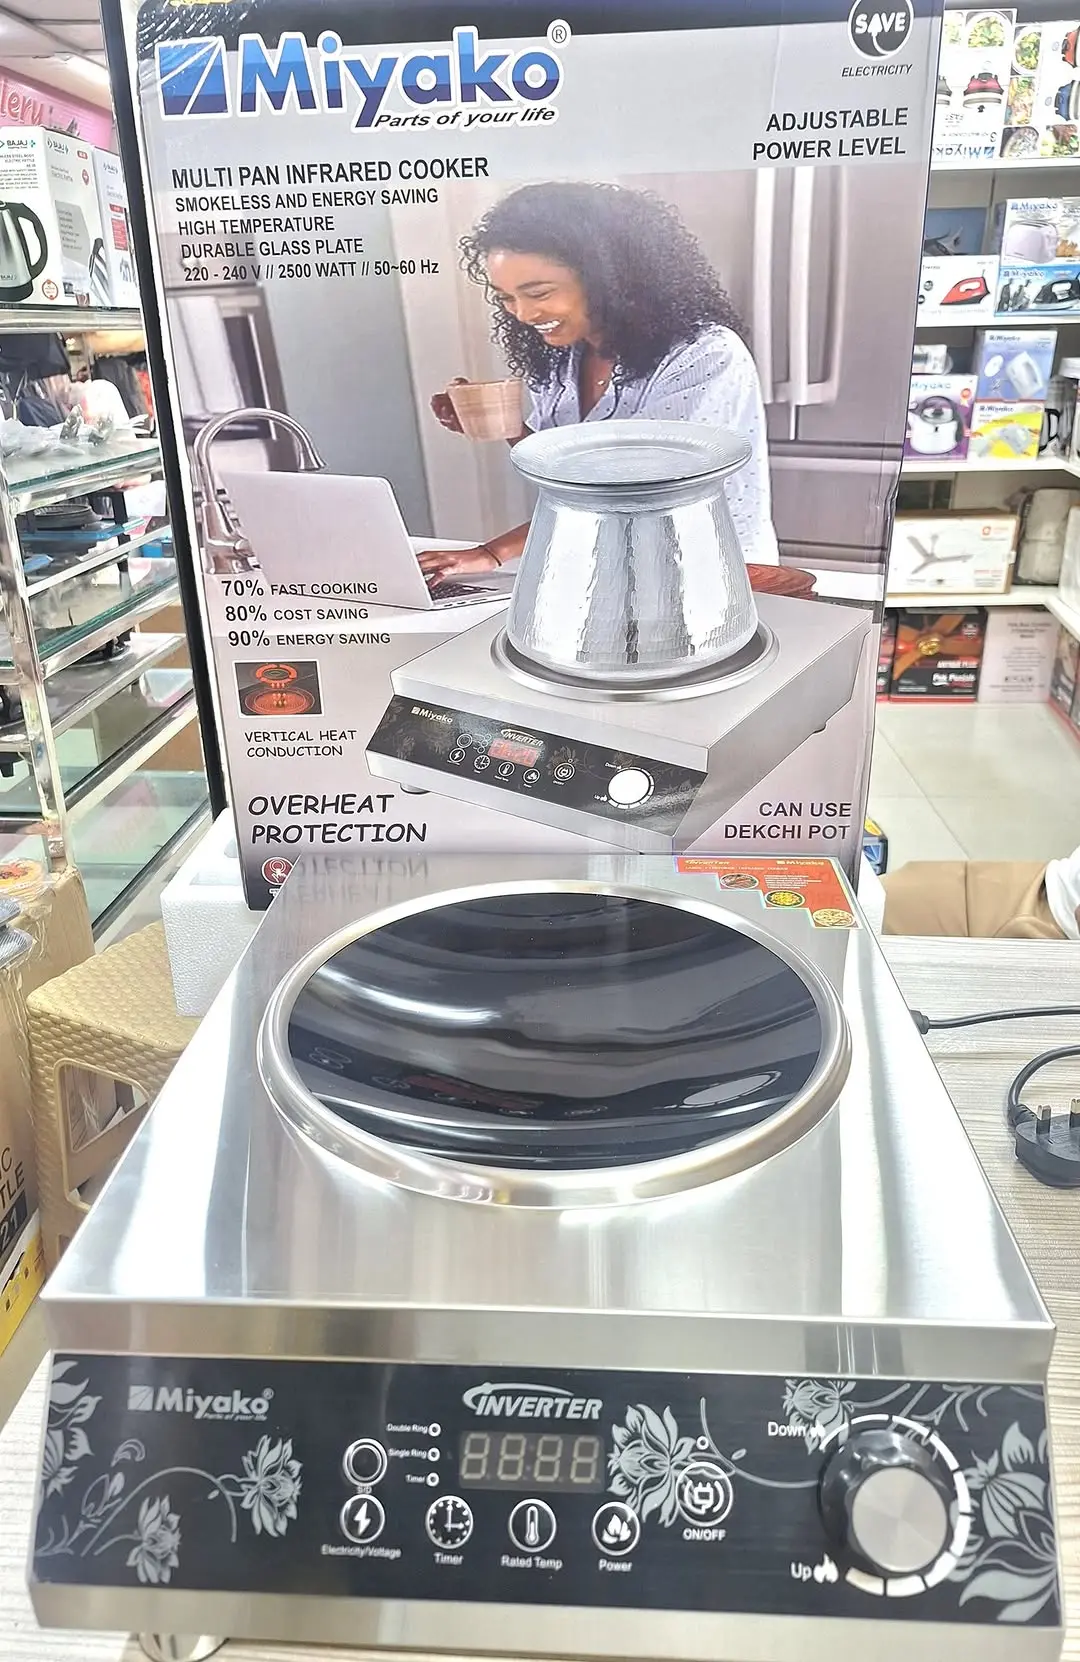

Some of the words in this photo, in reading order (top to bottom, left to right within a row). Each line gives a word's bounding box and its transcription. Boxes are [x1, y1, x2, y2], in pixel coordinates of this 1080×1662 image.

[855, 12, 906, 35] SAVE
[841, 64, 913, 77] ELECTRICITY
[240, 31, 561, 128] Miyako
[374, 114, 431, 128] Parts
[436, 111, 462, 125] of
[464, 111, 518, 127] your
[520, 107, 556, 122] life
[766, 107, 909, 132] ADJUSTABLE
[752, 140, 831, 160] POWER
[838, 136, 906, 157] LEVEL
[931, 144, 982, 159] Miyak
[171, 167, 233, 189] MULTI
[239, 165, 280, 186] PAN
[286, 161, 392, 185] INFRARED
[398, 157, 490, 180] COOKER
[175, 194, 271, 212] SMOKELESS
[275, 193, 308, 209] AND
[312, 190, 376, 207] ENERGY
[381, 188, 439, 205] SAVING
[178, 220, 216, 235] HIGH
[220, 216, 335, 235] TEMPERATURE
[181, 242, 255, 259] DURABLE
[259, 240, 311, 257] GLASS
[315, 238, 364, 254] PLATE
[184, 266, 209, 282] 220
[222, 265, 248, 281] 240
[251, 264, 261, 280] V
[278, 263, 312, 279] 2500
[315, 262, 357, 278] WATT
[374, 260, 416, 276] 50~60
[421, 259, 440, 274] Hz
[221, 579, 264, 597] 70%
[271, 583, 306, 596] FAST
[310, 582, 378, 595] COOKING
[225, 605, 267, 622] 80%
[273, 609, 312, 621] COST
[316, 608, 369, 620] SAVING
[228, 630, 270, 647] 90%
[276, 634, 334, 646] ENERGY
[338, 632, 391, 645] SAVING
[420, 708, 453, 724] Miyako
[244, 731, 314, 743] VERTICAL
[319, 730, 357, 741] HEAT
[503, 730, 544, 747] INVERTER
[247, 745, 344, 758] CONDUCTION
[248, 793, 395, 815] OVERHEAT
[759, 802, 803, 817] CAN
[810, 802, 852, 817] USE
[251, 823, 427, 844] PROTECTION
[724, 824, 802, 839] DEKCHI
[808, 825, 851, 840] POT
[155, 1386, 270, 1420] Miyako
[475, 1395, 603, 1420] INVERTER
[386, 1423, 411, 1432] Double
[412, 1424, 428, 1434] Ring
[767, 1421, 806, 1437] Down
[388, 1448, 410, 1458] Single
[411, 1449, 427, 1459] Ring
[405, 1474, 426, 1483] Timer
[682, 1529, 727, 1541] ON/OFF
[433, 1551, 463, 1565] Timer
[501, 1555, 533, 1568] Rated
[534, 1557, 563, 1570] Temp
[598, 1559, 632, 1572] Power
[790, 1562, 813, 1582] Up
